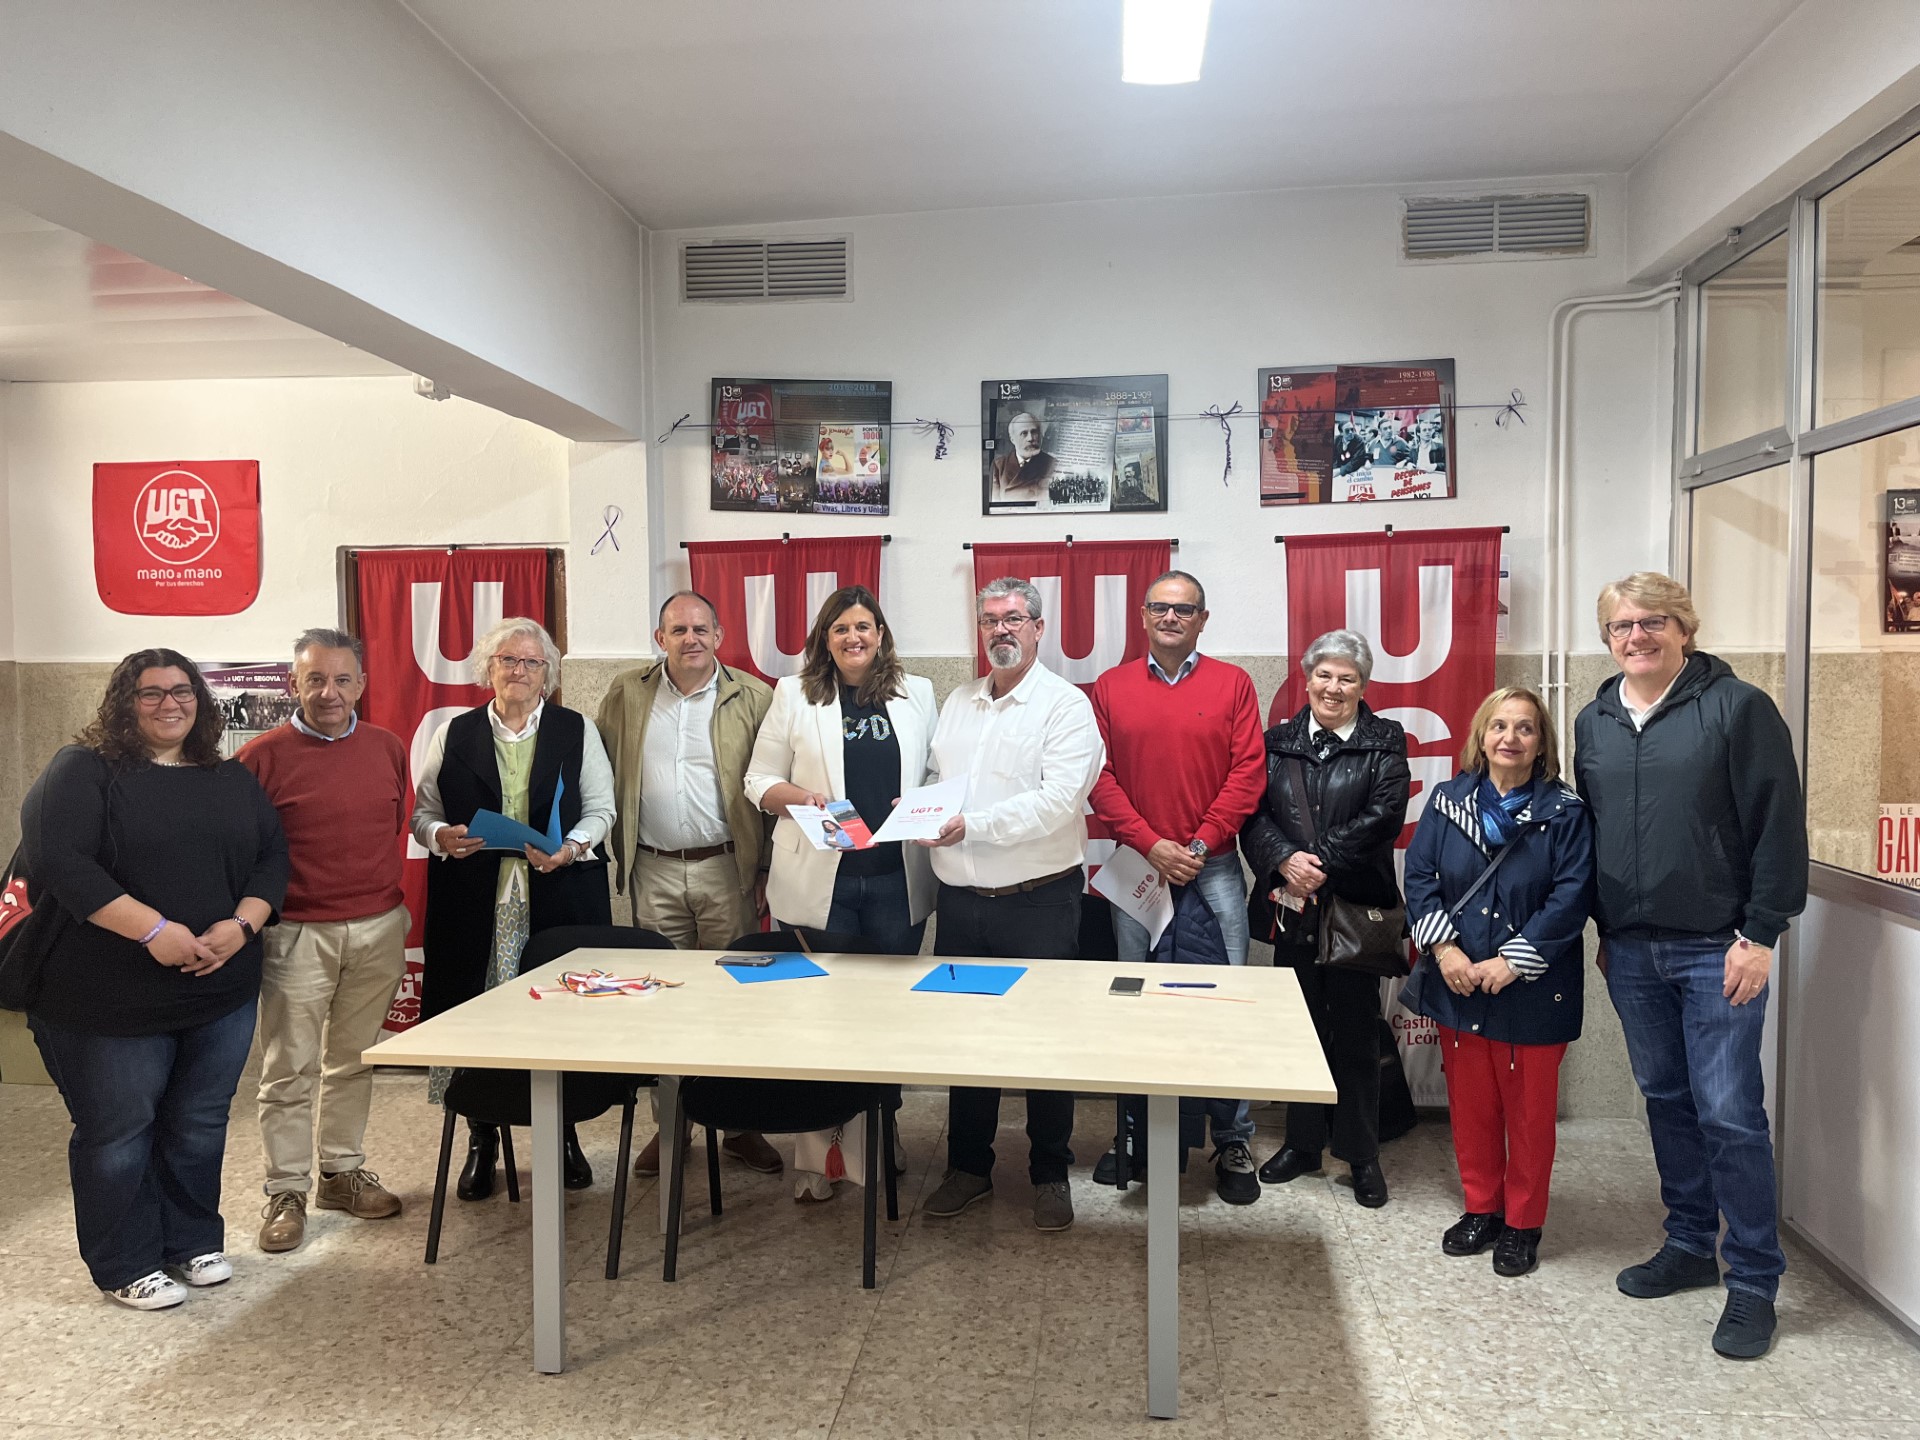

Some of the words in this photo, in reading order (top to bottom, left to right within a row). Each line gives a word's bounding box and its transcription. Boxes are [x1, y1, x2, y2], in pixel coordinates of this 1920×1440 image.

[1399, 371, 1436, 379] 1982-1988
[1105, 391, 1152, 400] 1888-1909
[737, 401, 767, 419] UGT
[1403, 478, 1412, 487] DE
[1349, 484, 1373, 495] UGT
[1391, 482, 1431, 498] PENSIONES
[146, 488, 206, 523] UGT
[822, 505, 839, 514] Vivas,
[841, 505, 861, 513] Libres
[137, 569, 175, 580] mano
[184, 568, 223, 579] mano
[1879, 807, 1889, 815] SI
[1900, 807, 1913, 815] LE
[1132, 880, 1149, 899] UGT
